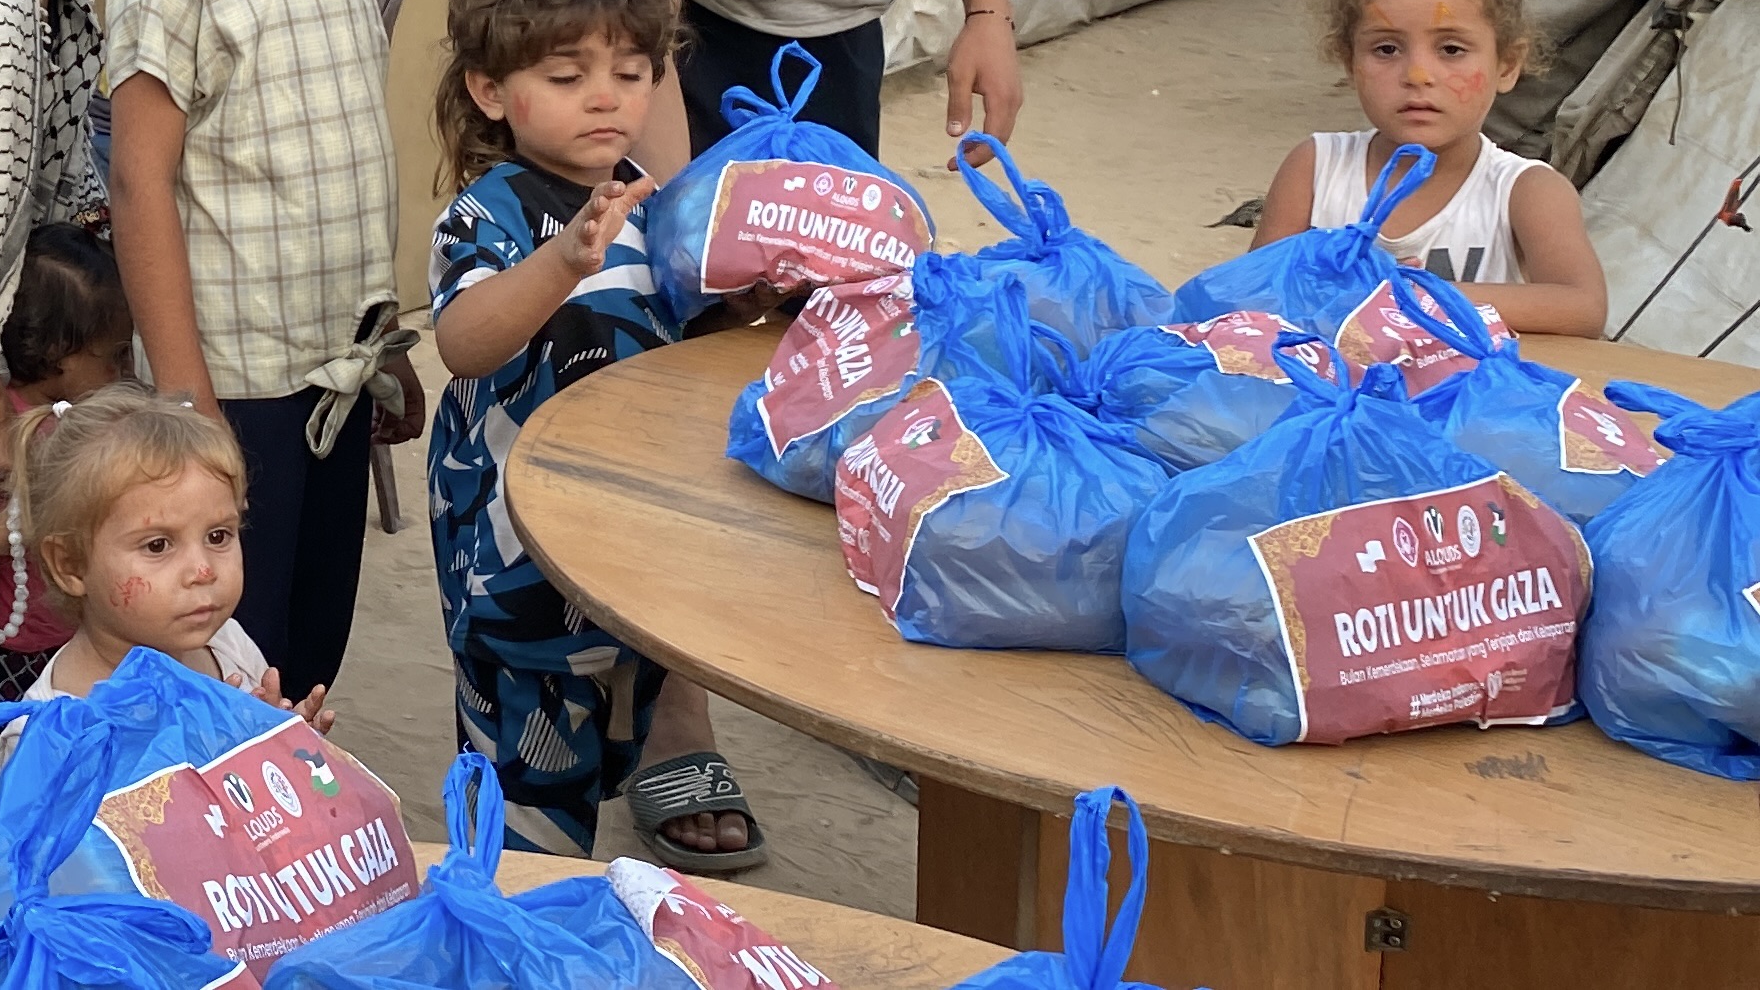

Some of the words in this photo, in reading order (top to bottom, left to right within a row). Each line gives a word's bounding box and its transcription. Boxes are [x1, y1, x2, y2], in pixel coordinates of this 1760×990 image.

[746, 199, 798, 232] ROTI
[797, 208, 872, 254] UNTUK
[1424, 544, 1462, 566] ALQUDS
[1333, 603, 1402, 658] ROTI
[1489, 566, 1562, 622] GAZA
[242, 805, 284, 842] LQUDS
[339, 817, 399, 887] GAZA
